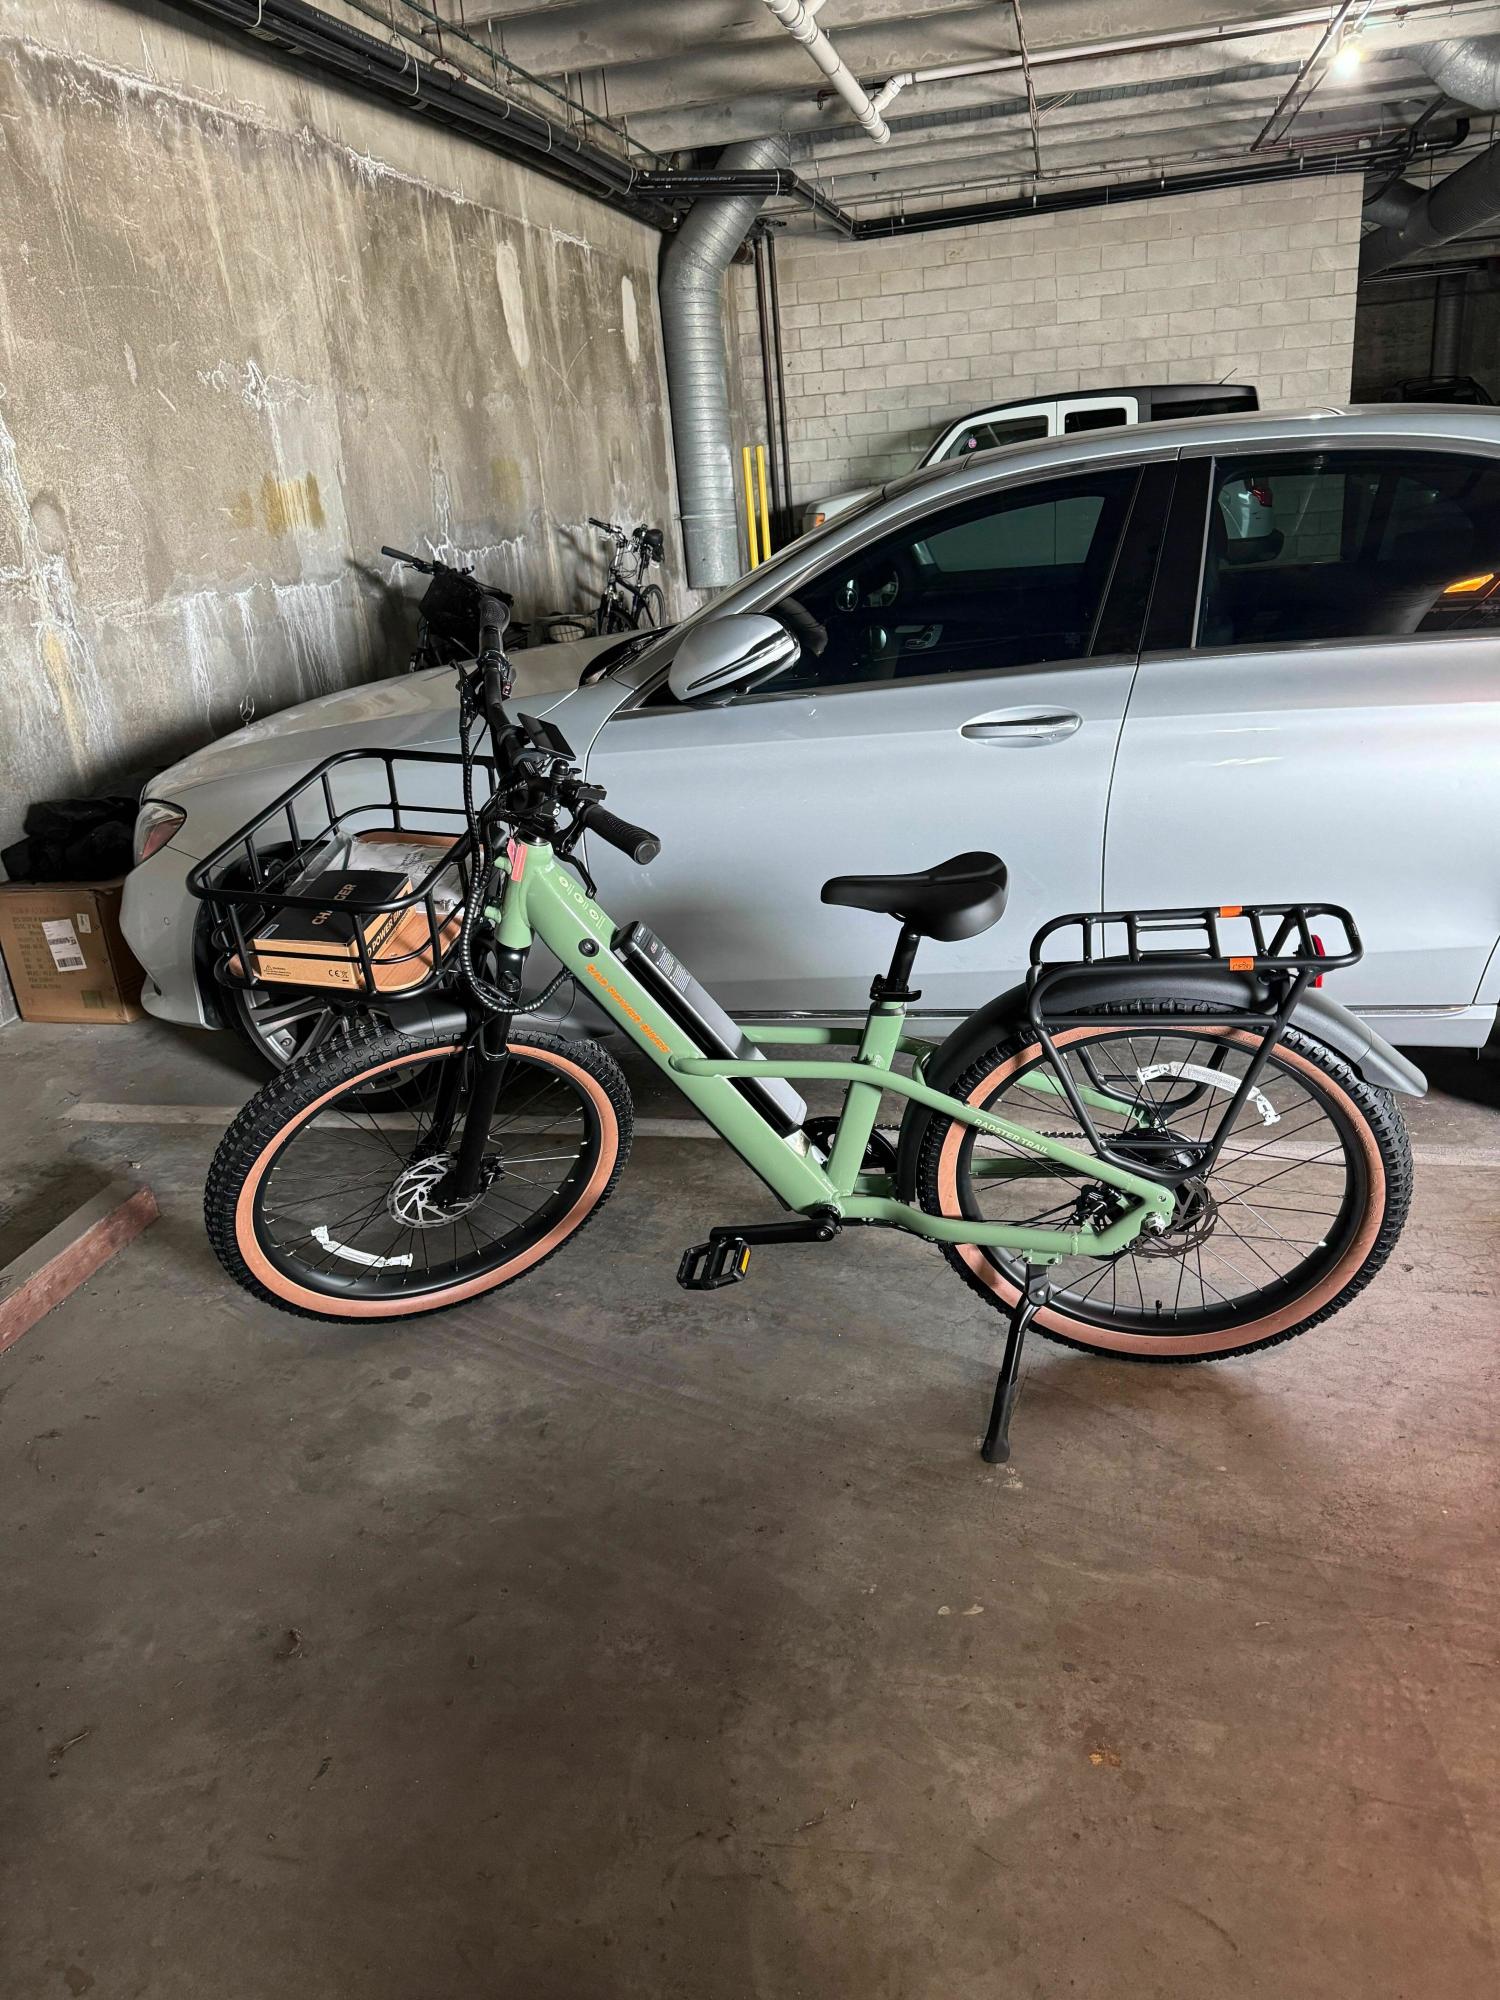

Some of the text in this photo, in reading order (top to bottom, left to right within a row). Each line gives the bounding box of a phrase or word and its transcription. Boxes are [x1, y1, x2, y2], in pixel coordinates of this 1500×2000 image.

[312, 884, 357, 925] CHGER
[372, 918, 393, 951] POWER
[606, 985, 641, 1023] POWER
[974, 1118, 1049, 1154] RADSTER TRAIL
